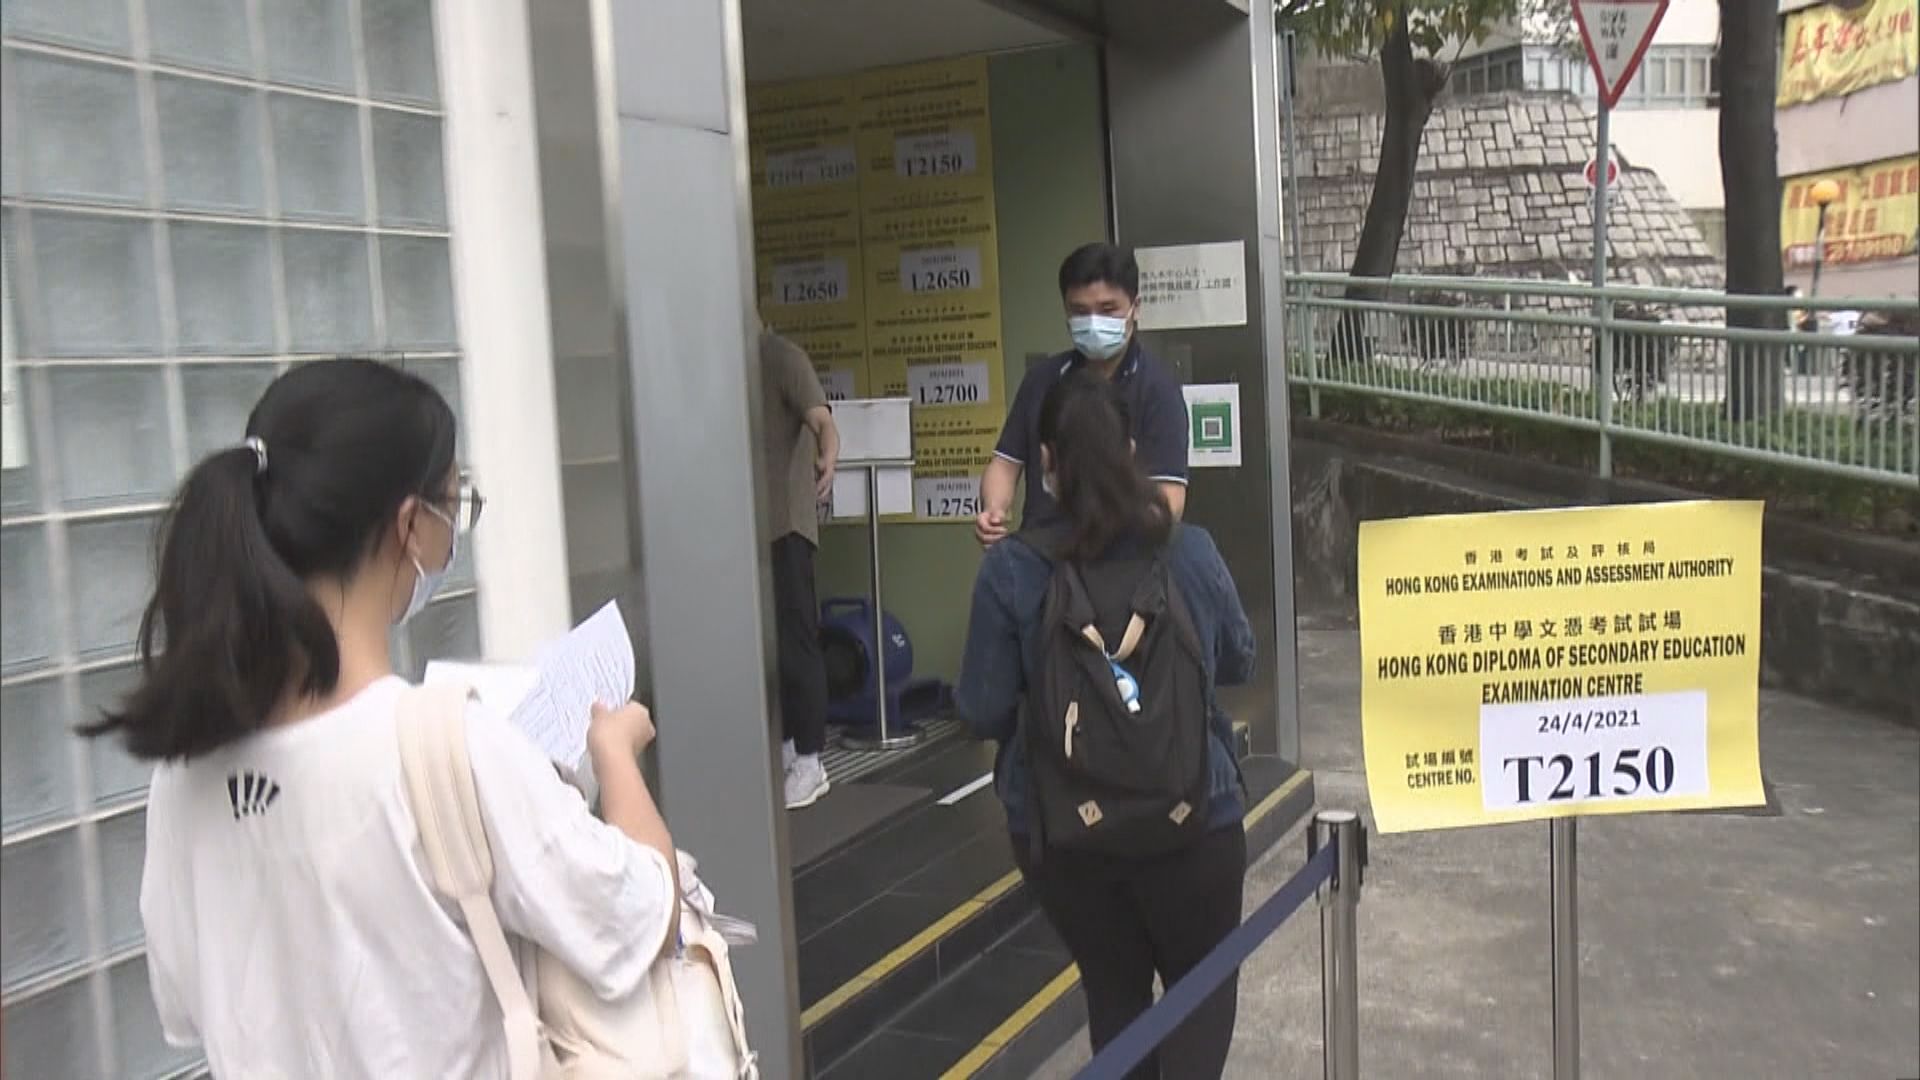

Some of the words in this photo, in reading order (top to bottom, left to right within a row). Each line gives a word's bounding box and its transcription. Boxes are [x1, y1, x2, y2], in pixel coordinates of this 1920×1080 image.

[905, 154, 962, 177] T2150
[911, 269, 970, 292] L2650
[919, 385, 978, 405] L2700
[1464, 540, 1657, 565] 香港考試及評核局
[1386, 576, 1421, 594] HONG
[1425, 573, 1458, 593] KONG
[1463, 568, 1553, 591] EXAMINATIONS
[1556, 566, 1582, 586] AND
[1585, 563, 1665, 584] ASSESSMENT
[1667, 558, 1734, 579] AUTHORITY
[1437, 610, 1682, 645] 香港中學文憑考試試場
[1378, 656, 1421, 679] HONG
[1426, 653, 1468, 677] KONG
[1473, 647, 1541, 674] DIPLOMA
[1546, 646, 1565, 668] OF
[1569, 639, 1659, 666] SECONDARY
[1663, 634, 1745, 659] EDUCATION
[1482, 678, 1582, 704] EXAMINATION
[1587, 673, 1643, 696] CENTRE
[1538, 709, 1640, 735] 24/4/2021
[1405, 749, 1473, 768] 試場編號
[1408, 768, 1453, 787] CENTRE
[1455, 767, 1476, 785] NO.
[1503, 746, 1674, 804] T2150
